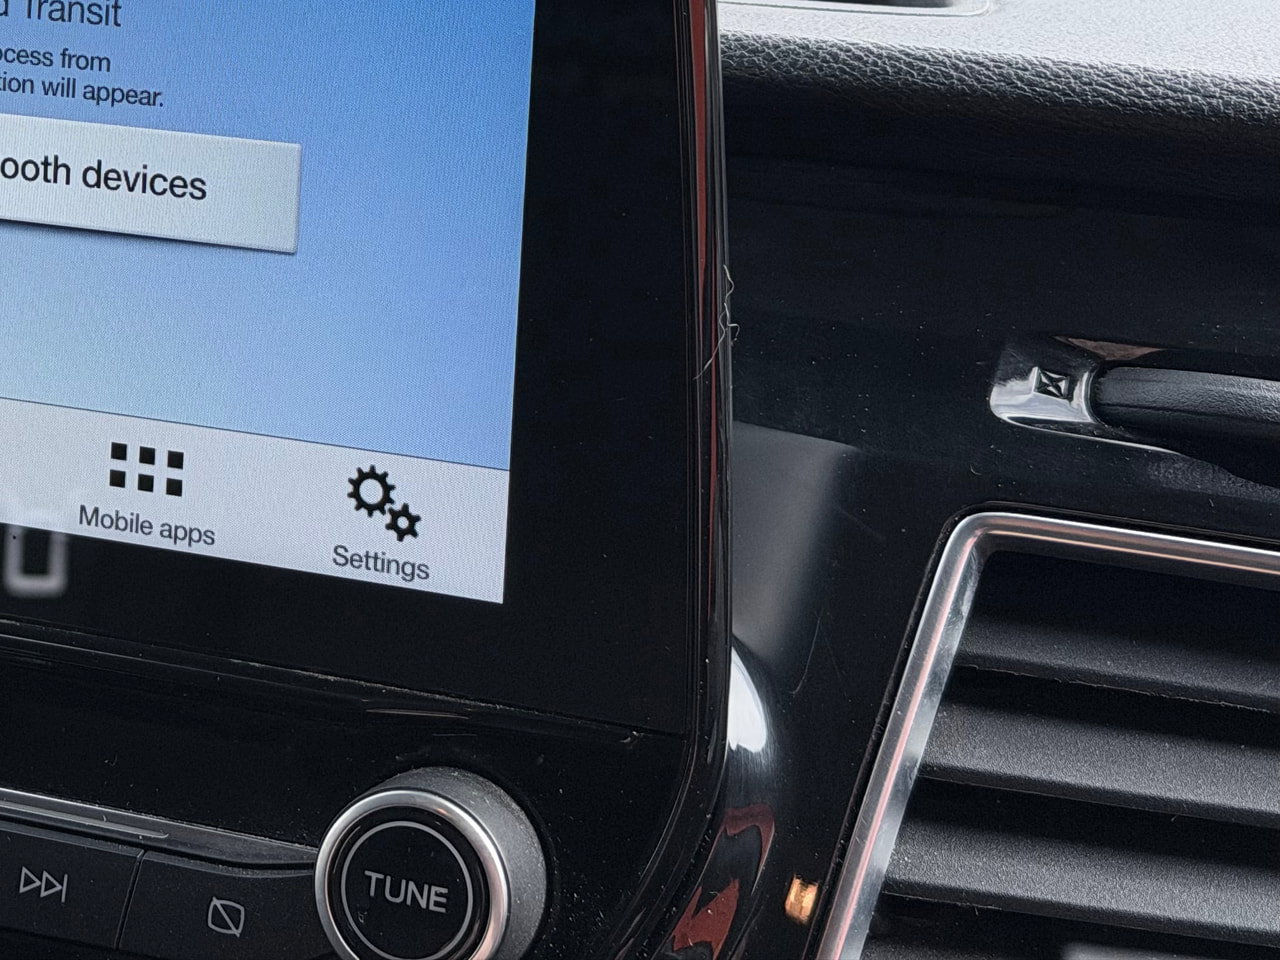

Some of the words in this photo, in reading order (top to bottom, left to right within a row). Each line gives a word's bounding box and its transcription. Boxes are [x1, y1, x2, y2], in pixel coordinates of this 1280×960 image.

[60, 47, 111, 72] from
[41, 76, 76, 98] will
[82, 83, 164, 108] appear.
[81, 160, 207, 201] devices
[78, 504, 153, 536] Mobile
[159, 519, 216, 547] apps
[332, 545, 430, 581] Settings
[364, 870, 449, 913] TUNE
